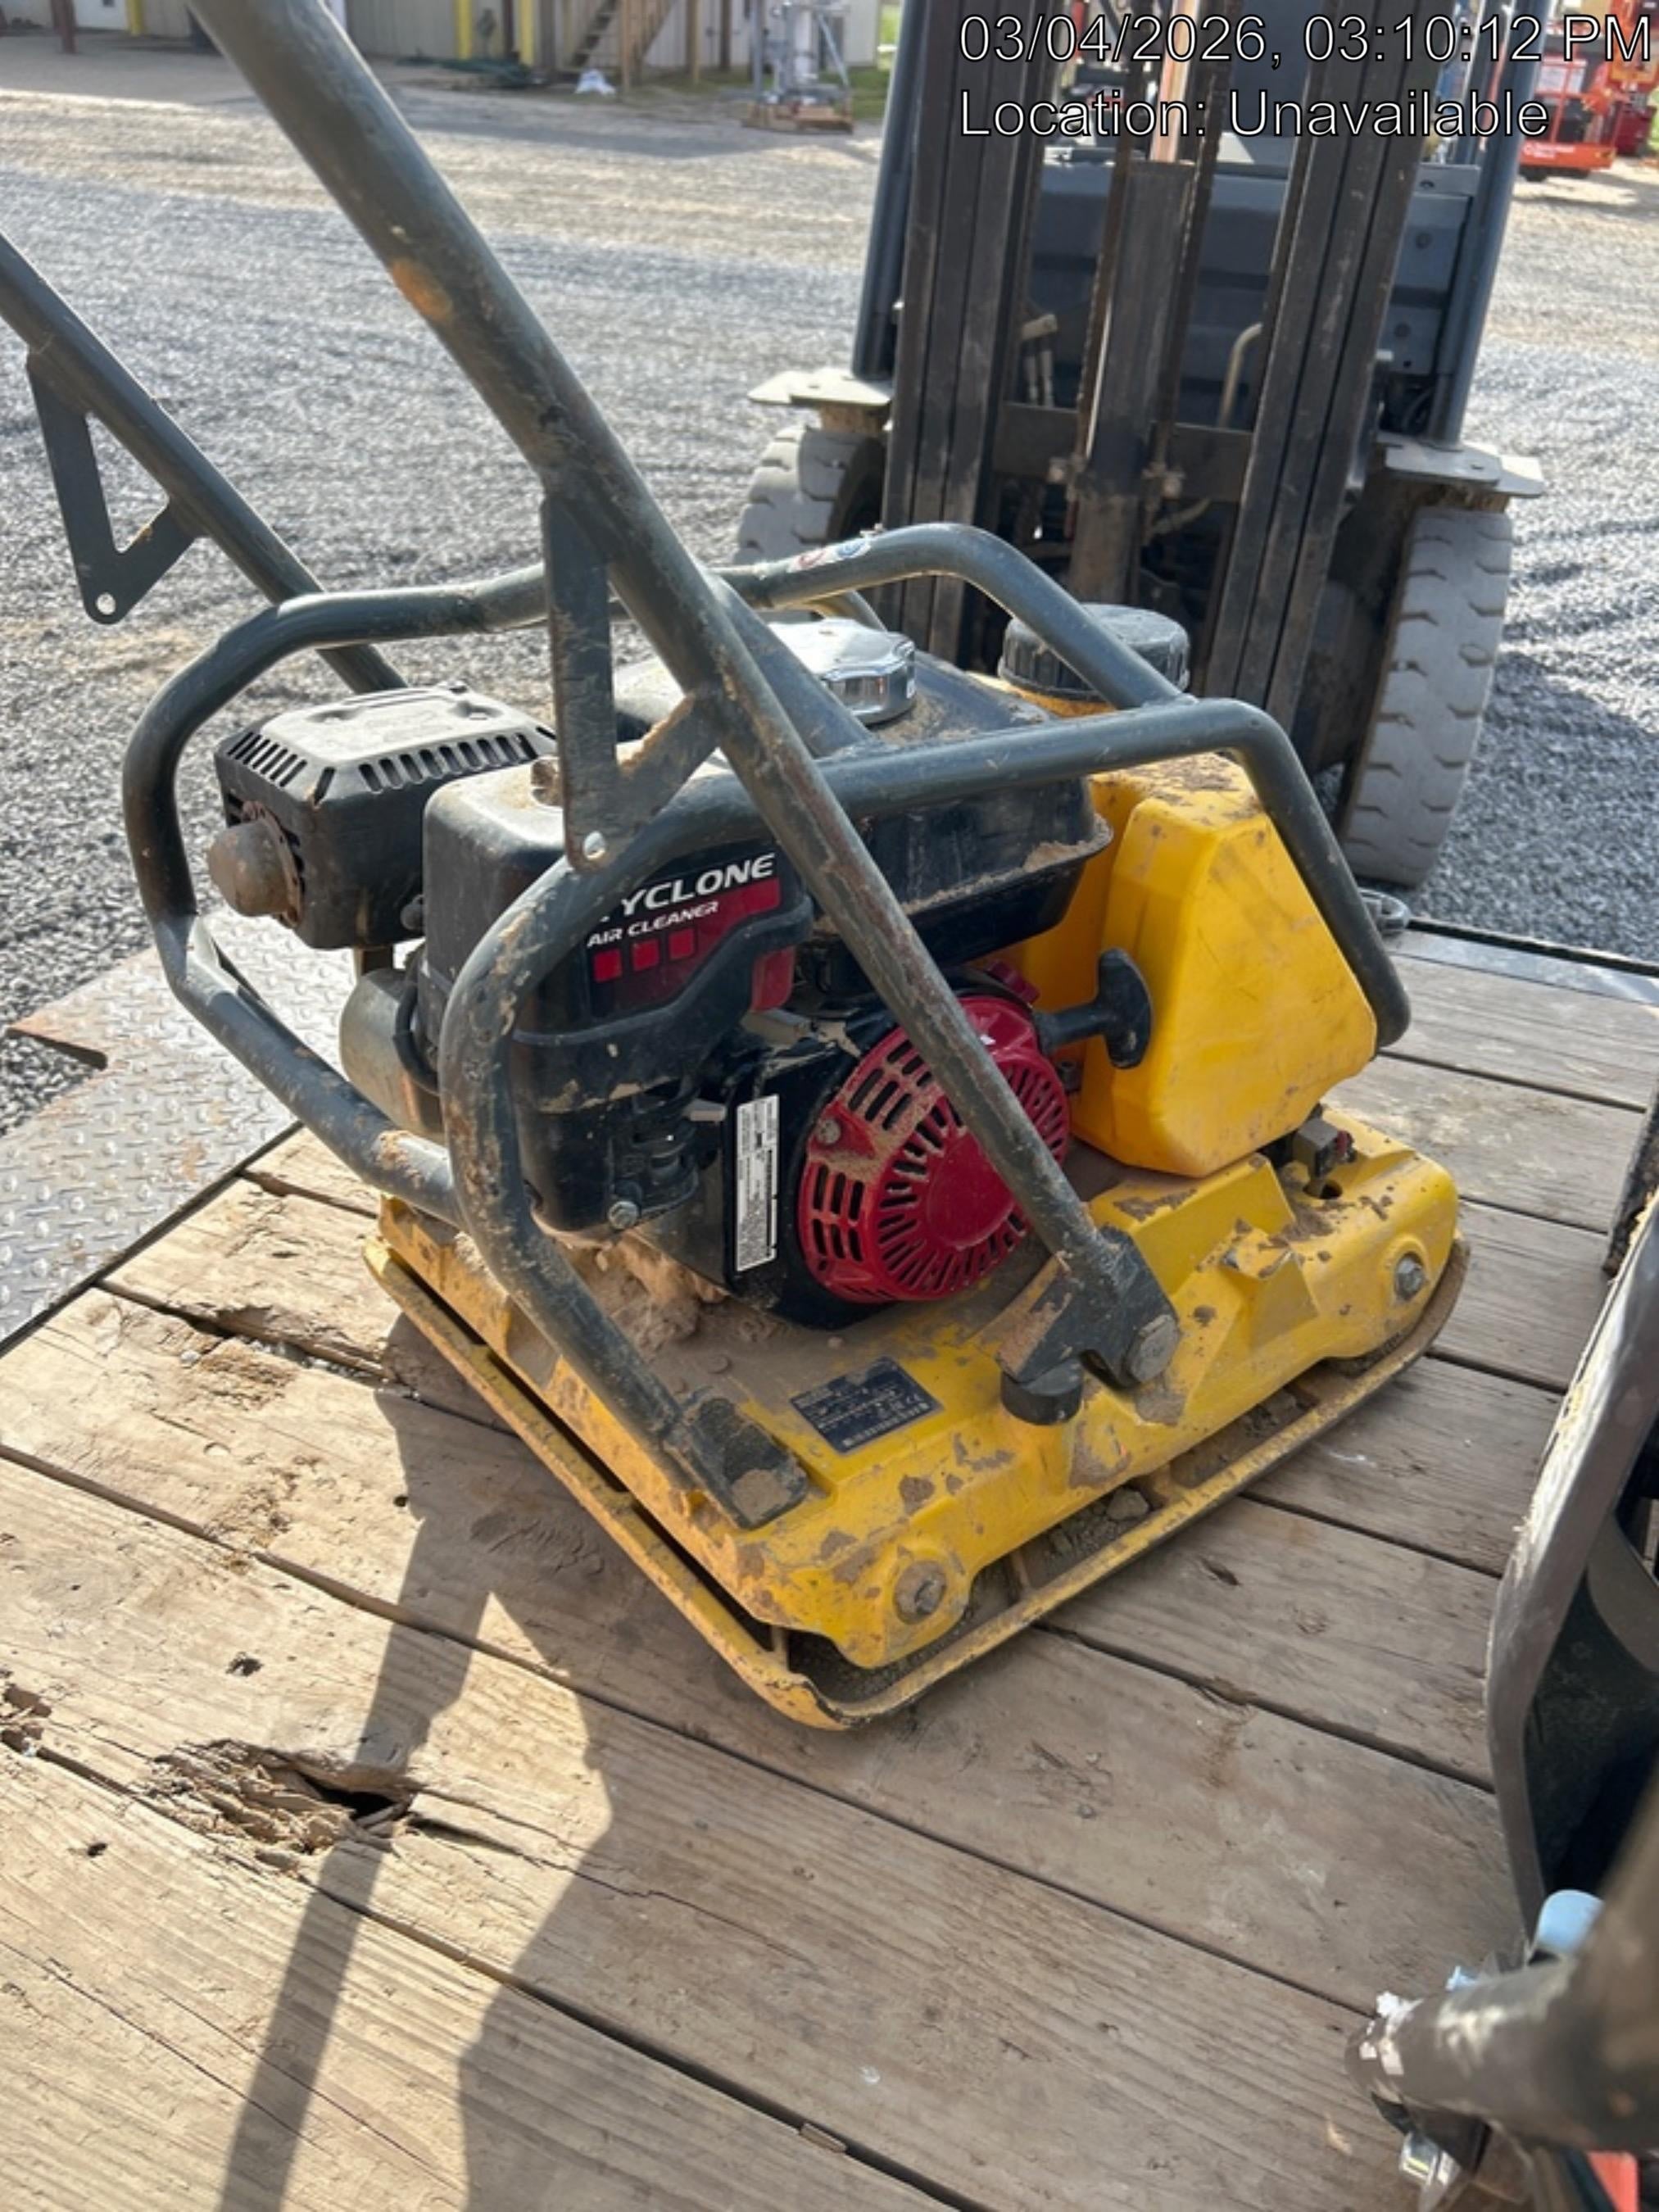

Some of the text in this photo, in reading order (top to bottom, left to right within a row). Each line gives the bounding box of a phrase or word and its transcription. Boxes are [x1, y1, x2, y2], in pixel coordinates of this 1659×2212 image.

[600, 853, 776, 922] YCLONE
[587, 901, 718, 947] AIR CLEANER
